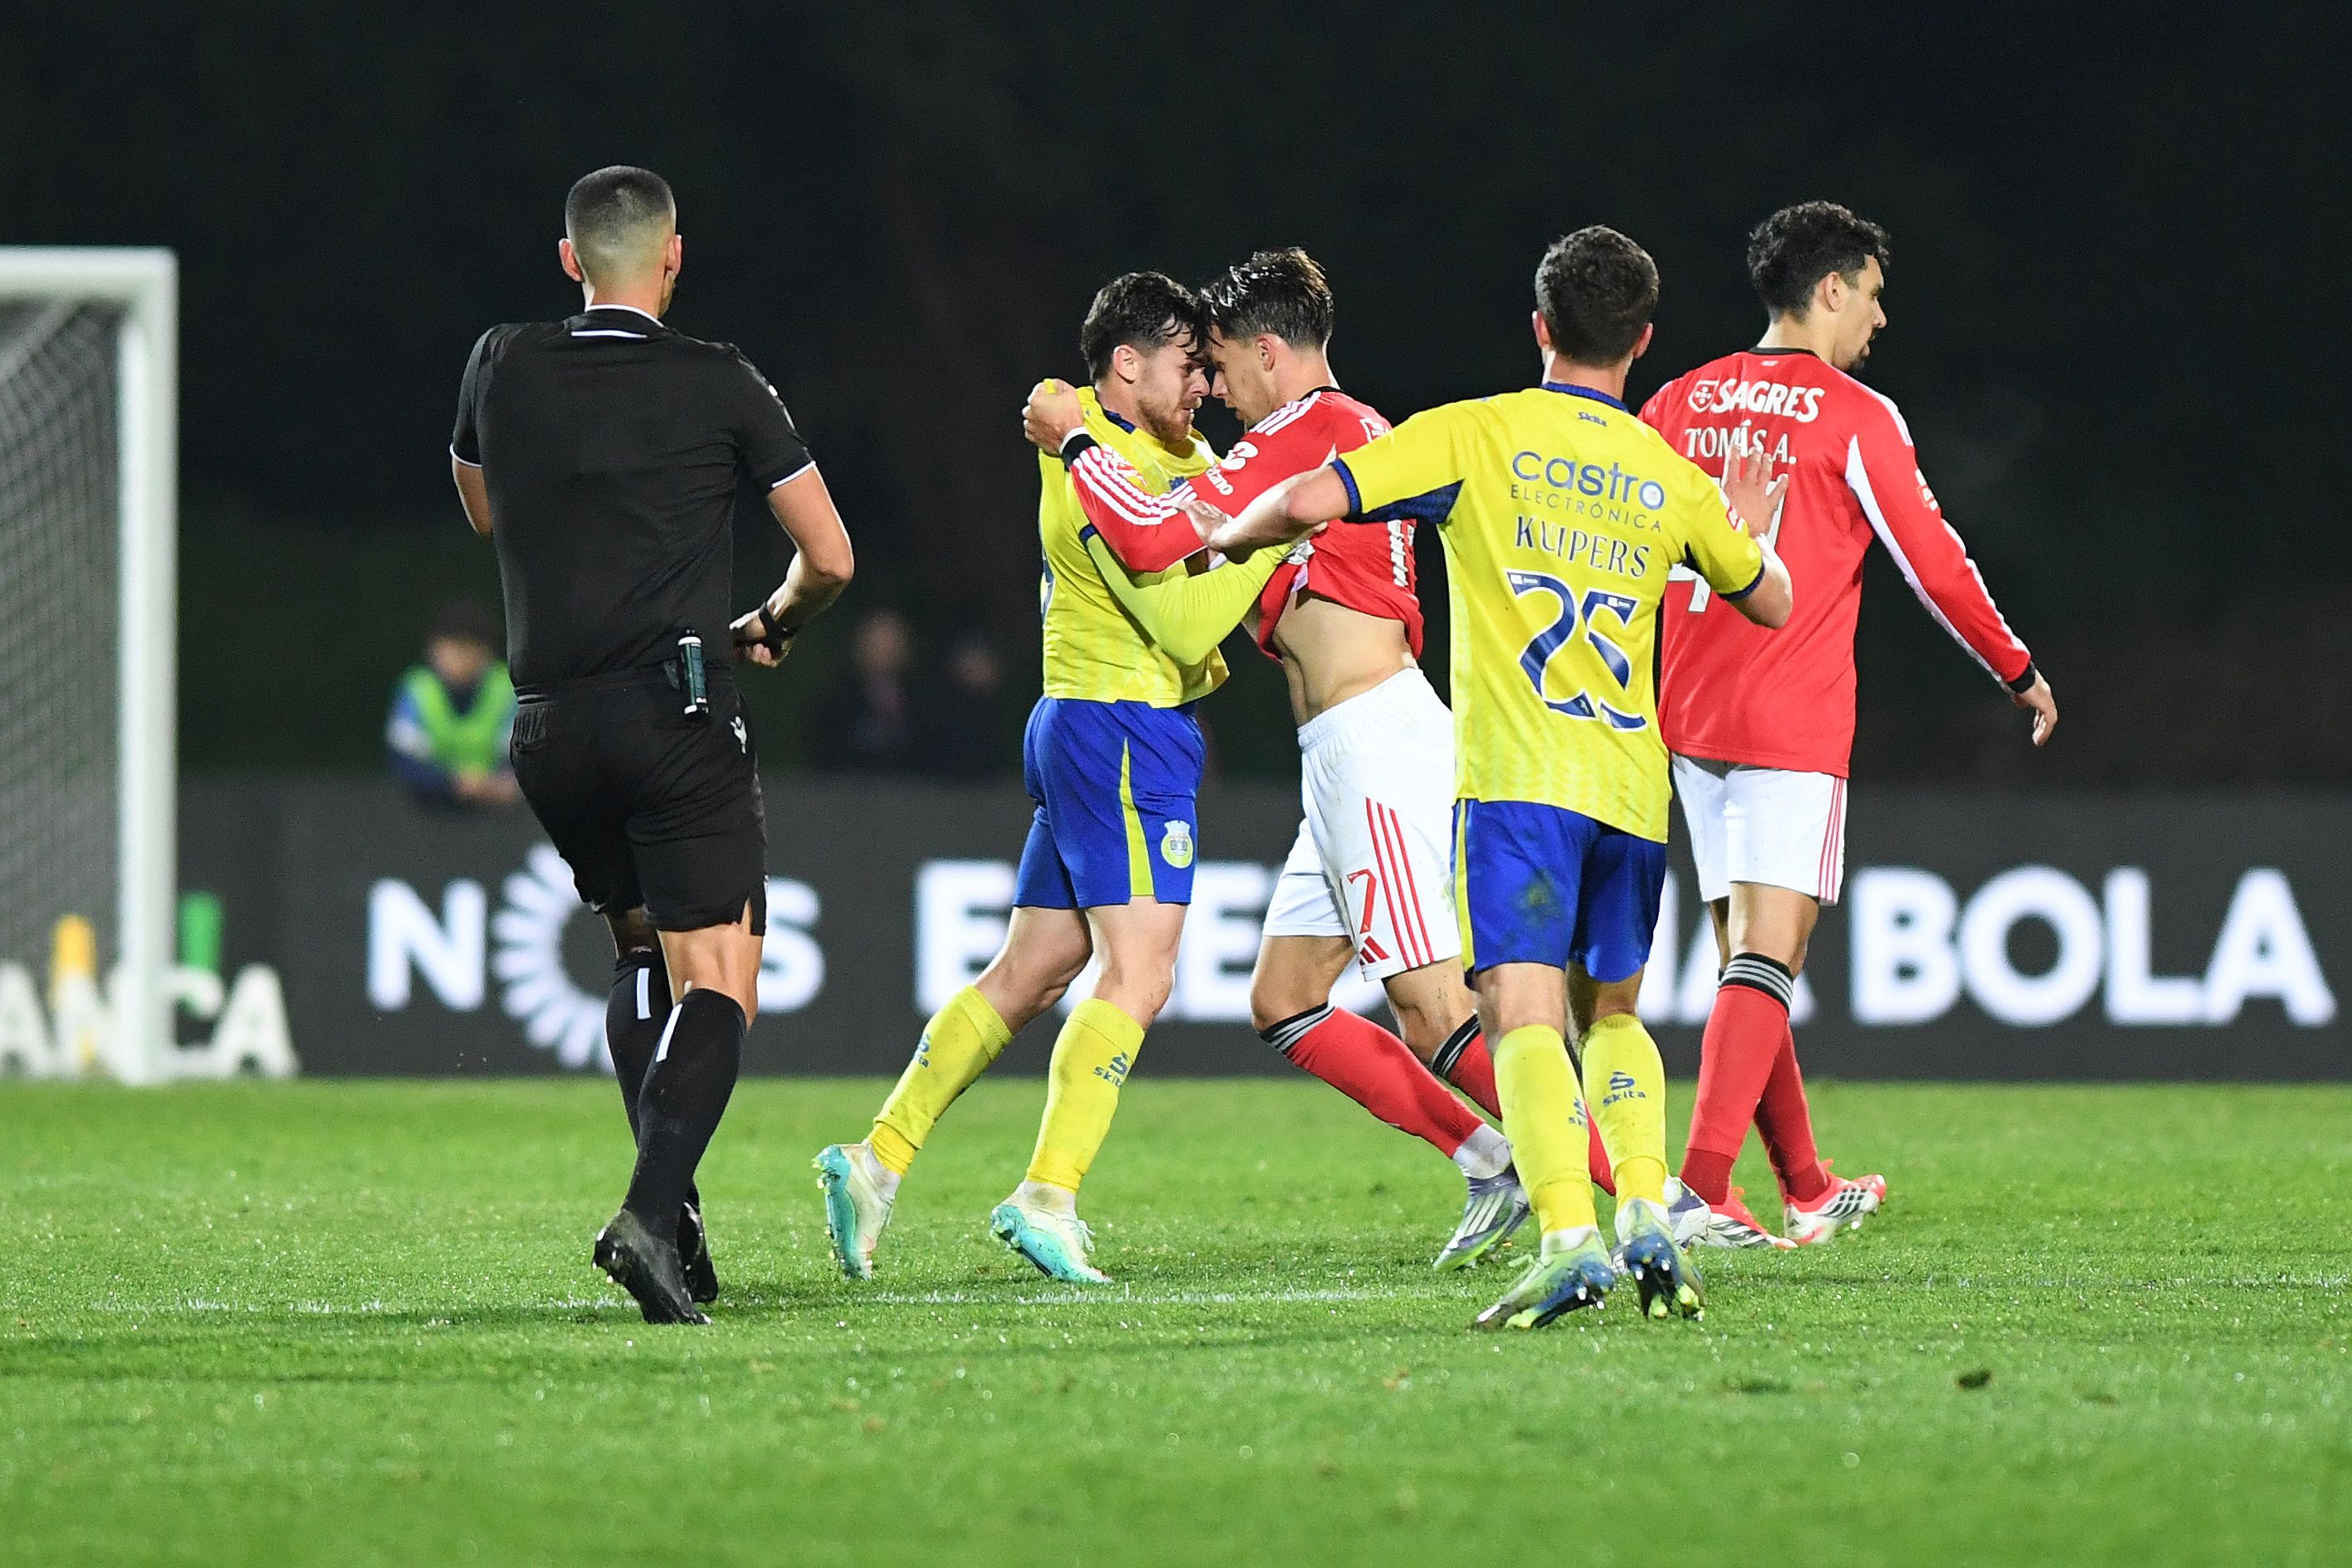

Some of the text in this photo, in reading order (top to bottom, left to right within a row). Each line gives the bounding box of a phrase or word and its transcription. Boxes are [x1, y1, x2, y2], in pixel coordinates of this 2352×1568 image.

[1709, 378, 1825, 423] SAGRES
[1685, 418, 1797, 464] TOMÁS A.
[1510, 484, 1661, 533] ELECTRÓNICA
[1513, 451, 1665, 510] castro
[1516, 514, 1651, 579] KUIPERS
[1506, 568, 1647, 732] 25
[1849, 865, 2337, 1027] BOLA
